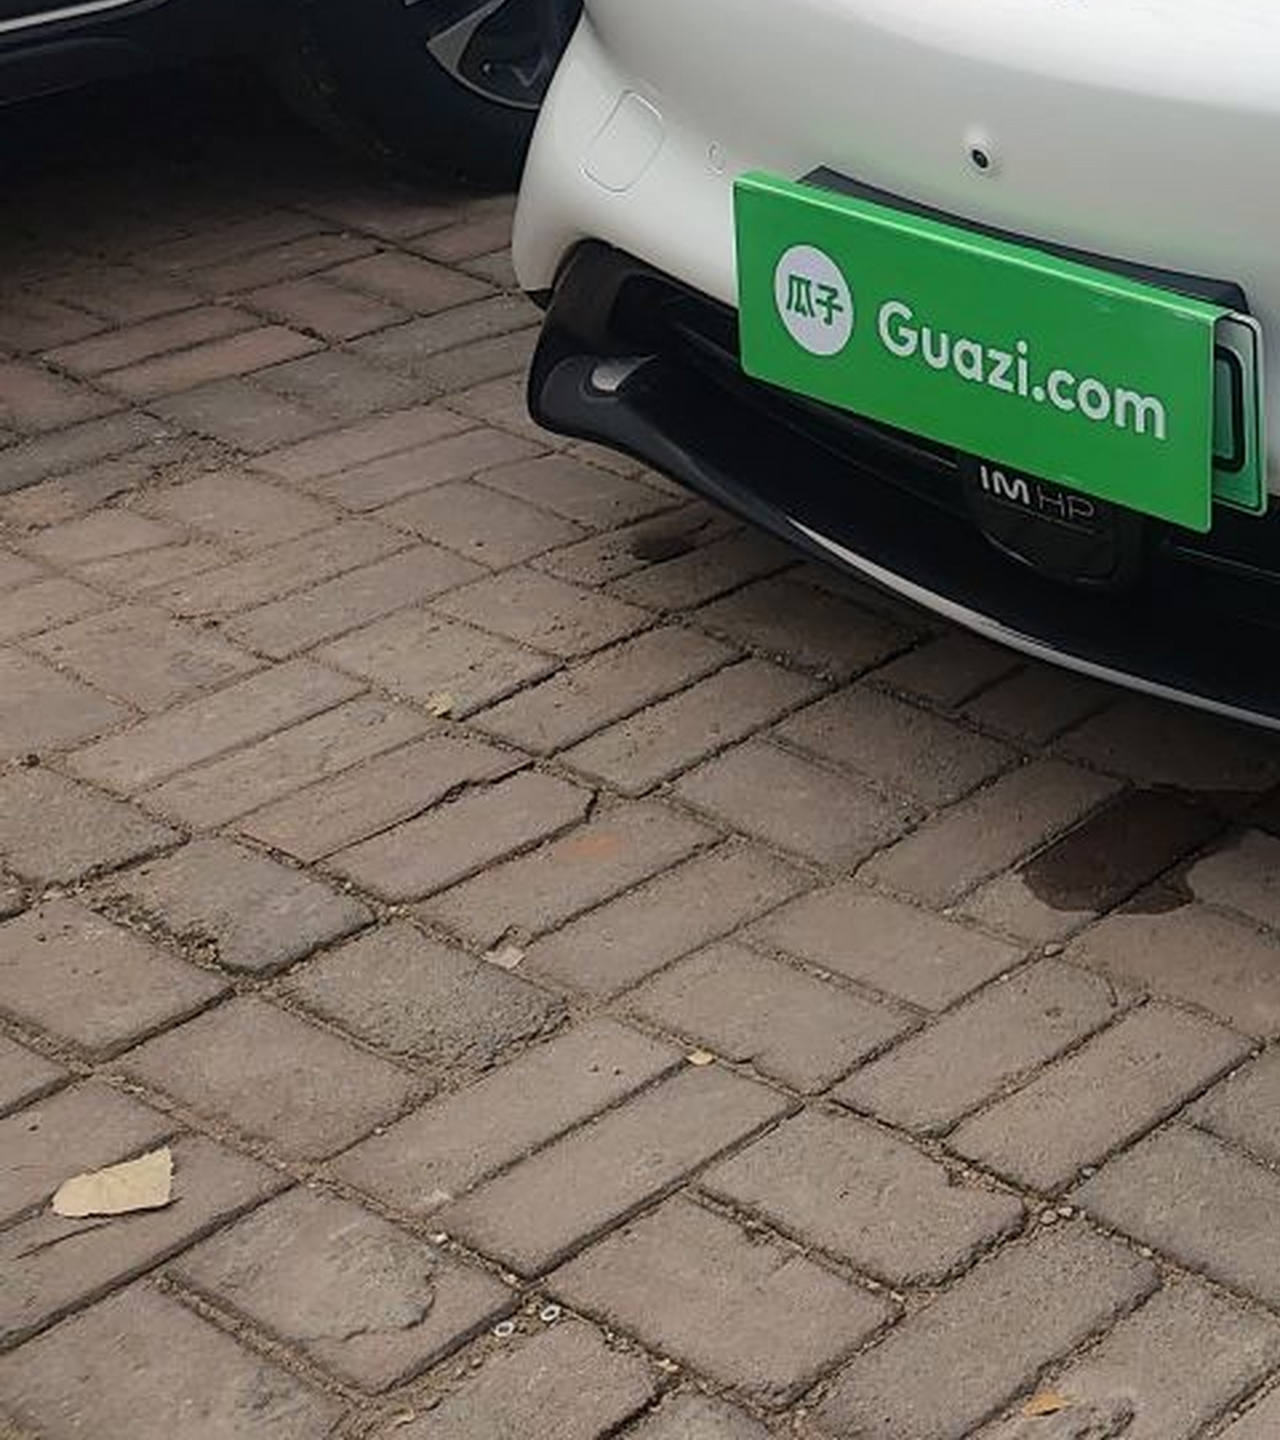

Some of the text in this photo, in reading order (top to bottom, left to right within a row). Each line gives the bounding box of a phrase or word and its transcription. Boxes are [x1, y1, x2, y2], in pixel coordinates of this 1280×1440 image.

[786, 274, 844, 325] 瓜子
[878, 300, 1166, 440] Guazi.com
[980, 464, 1031, 505] IM
